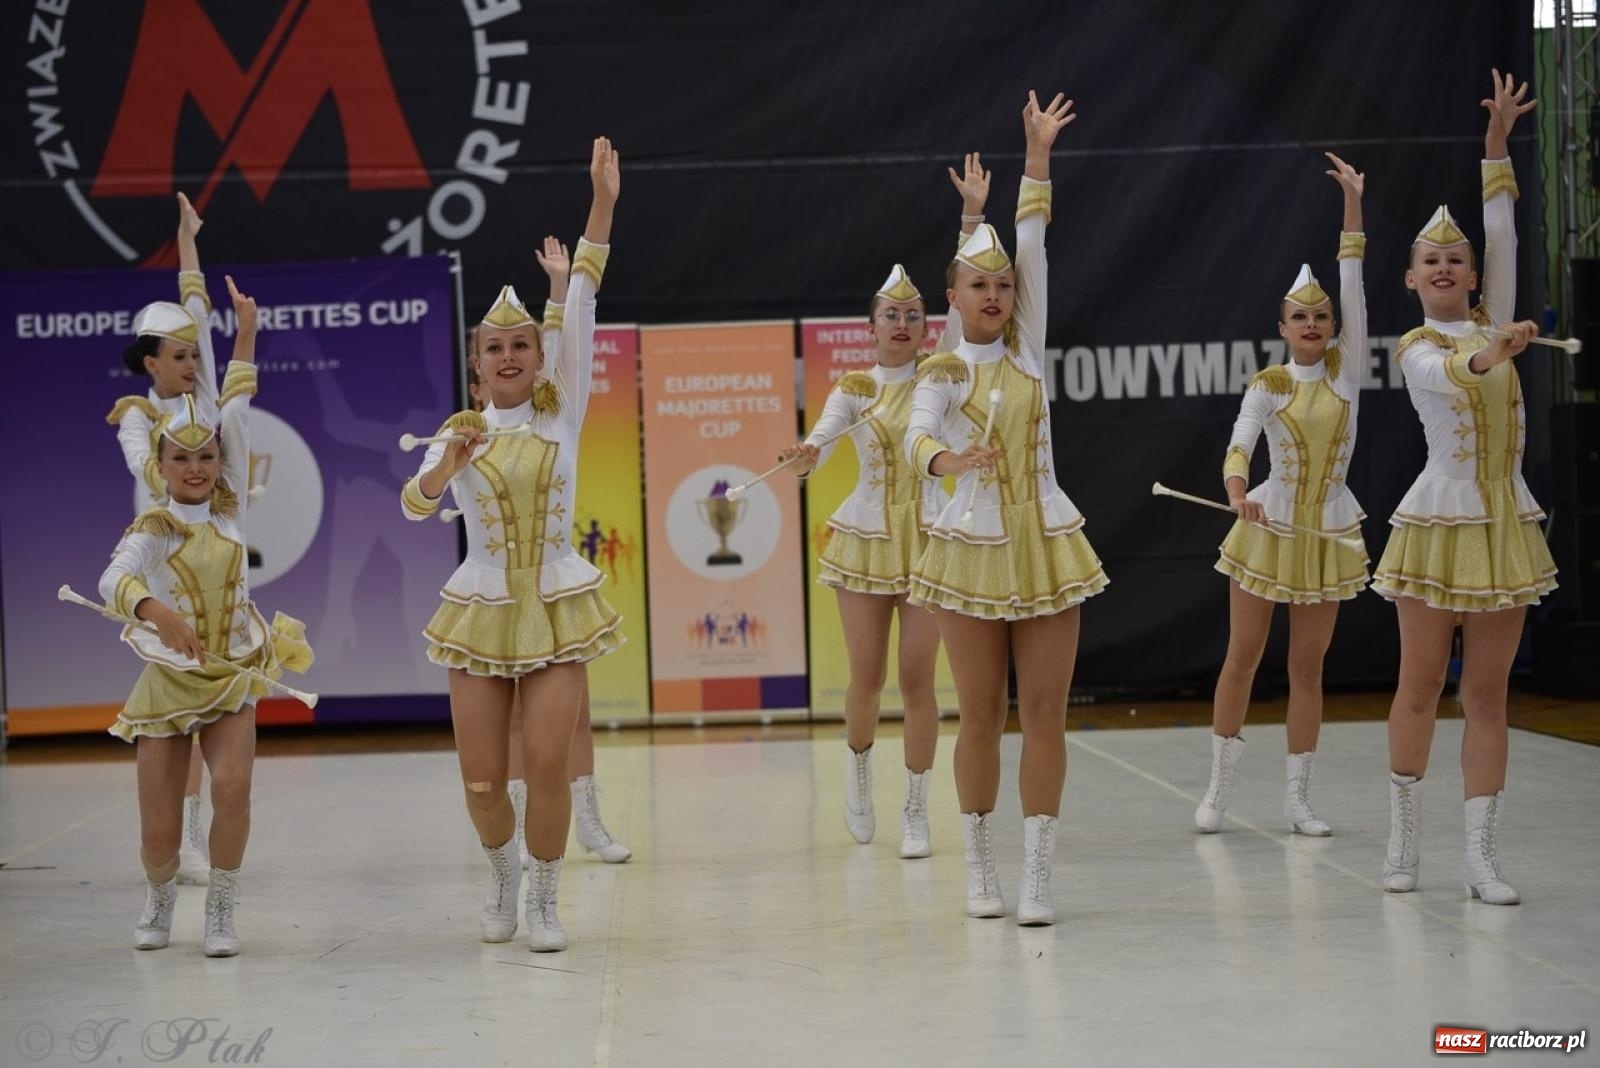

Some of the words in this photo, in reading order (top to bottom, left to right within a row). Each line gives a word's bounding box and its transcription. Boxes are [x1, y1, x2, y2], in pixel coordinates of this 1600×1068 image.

[17, 309, 138, 338] EUROPE
[208, 303, 362, 337] AJRETTES
[368, 299, 429, 326] CUP
[665, 373, 773, 394] EUROPEAN
[657, 396, 782, 420] MAJORETTES
[699, 421, 742, 439] CUP
